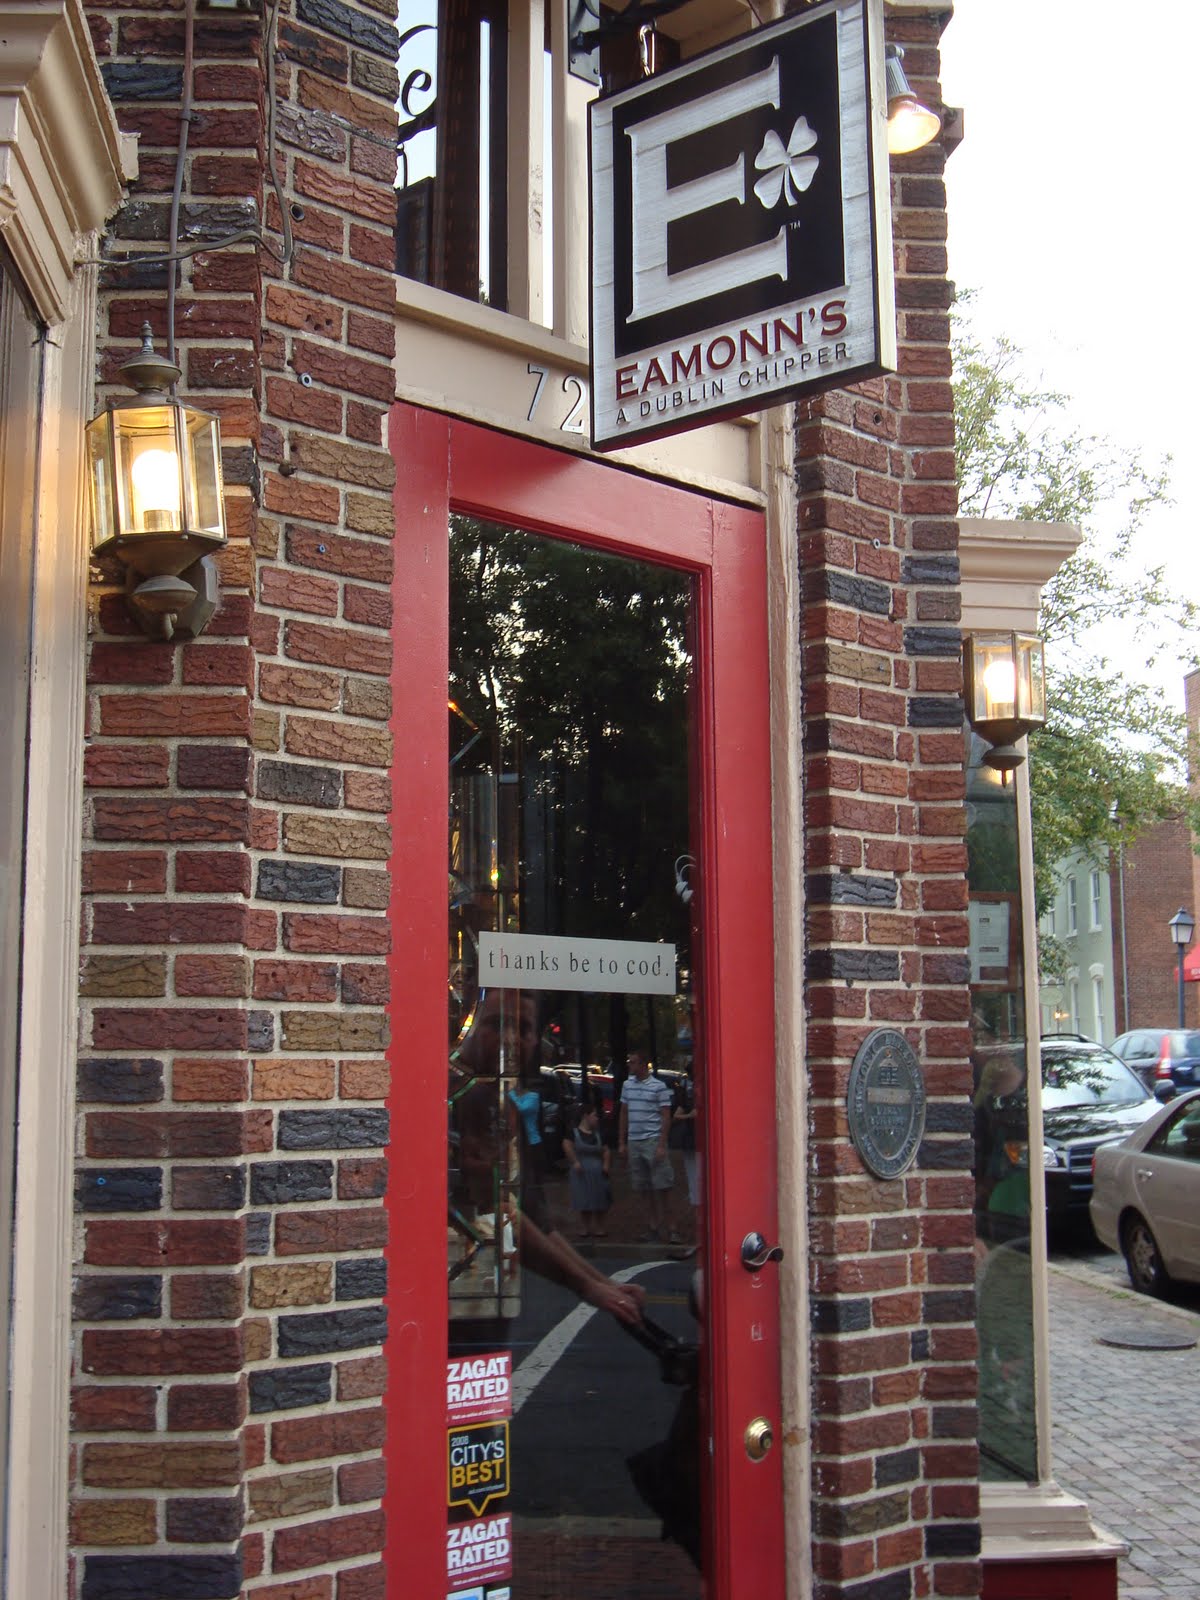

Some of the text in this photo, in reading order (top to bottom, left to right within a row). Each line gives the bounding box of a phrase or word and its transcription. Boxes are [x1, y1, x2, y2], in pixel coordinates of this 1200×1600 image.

[624, 54, 788, 324] E
[616, 300, 847, 401] EAMONN'S
[527, 363, 587, 435] 72
[615, 342, 848, 425] A DUBLIN CHIPPER
[489, 948, 669, 977] thanks be to cod.
[447, 1356, 509, 1383] ZAGAT
[447, 1376, 509, 1403] RATED
[451, 1440, 505, 1466] CITY'S
[451, 1458, 505, 1488] BEST
[447, 1517, 510, 1549] ZAGAT
[447, 1538, 510, 1570] RATED
